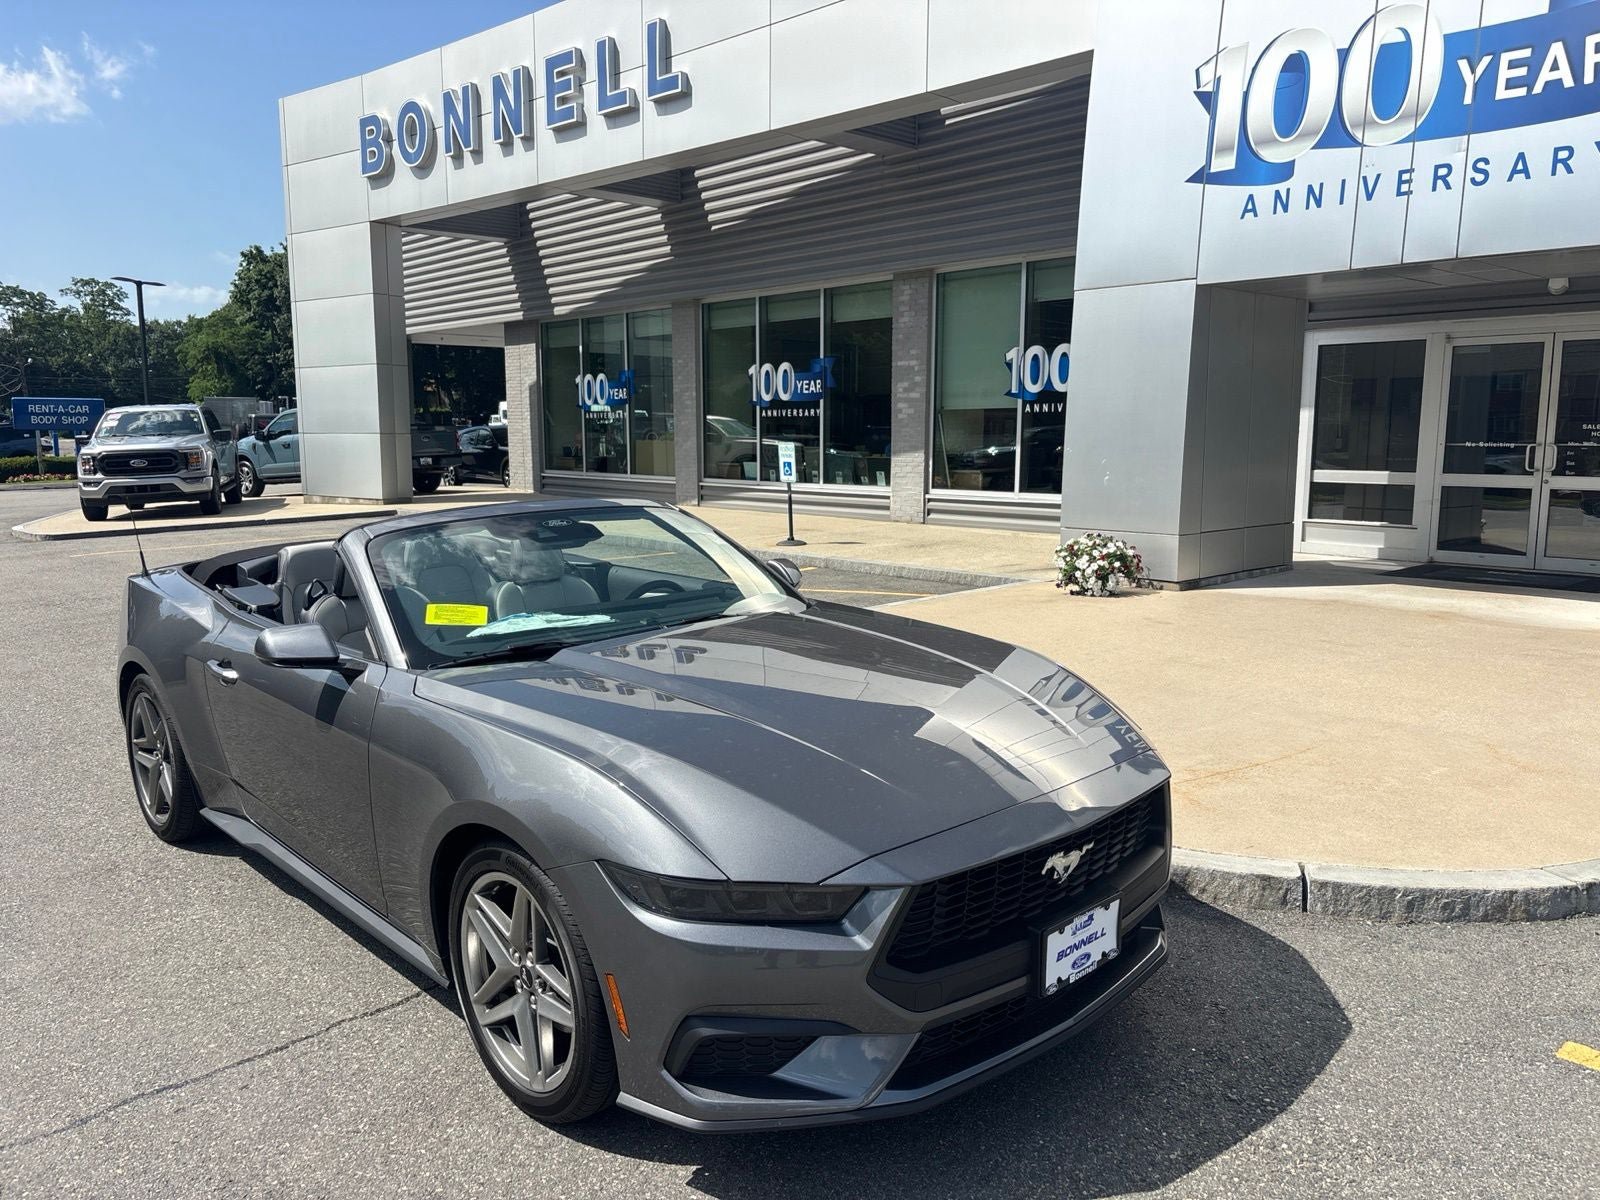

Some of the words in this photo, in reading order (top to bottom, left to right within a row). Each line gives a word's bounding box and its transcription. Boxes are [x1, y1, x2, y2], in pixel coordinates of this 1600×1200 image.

[359, 18, 688, 178] BONNELL
[1194, 2, 1444, 173] 100
[1240, 141, 1600, 220] ANNIVERSAR
[748, 361, 795, 401] 100
[796, 379, 822, 394] YEAR
[1005, 343, 1070, 393] 100
[575, 372, 609, 406] 100
[28, 404, 90, 414] RENT-A-CAR
[30, 415, 58, 425] BODY
[61, 415, 89, 425] SHOP
[761, 408, 821, 418] ANNIVERSARY
[1056, 928, 1106, 963] BONNELL
